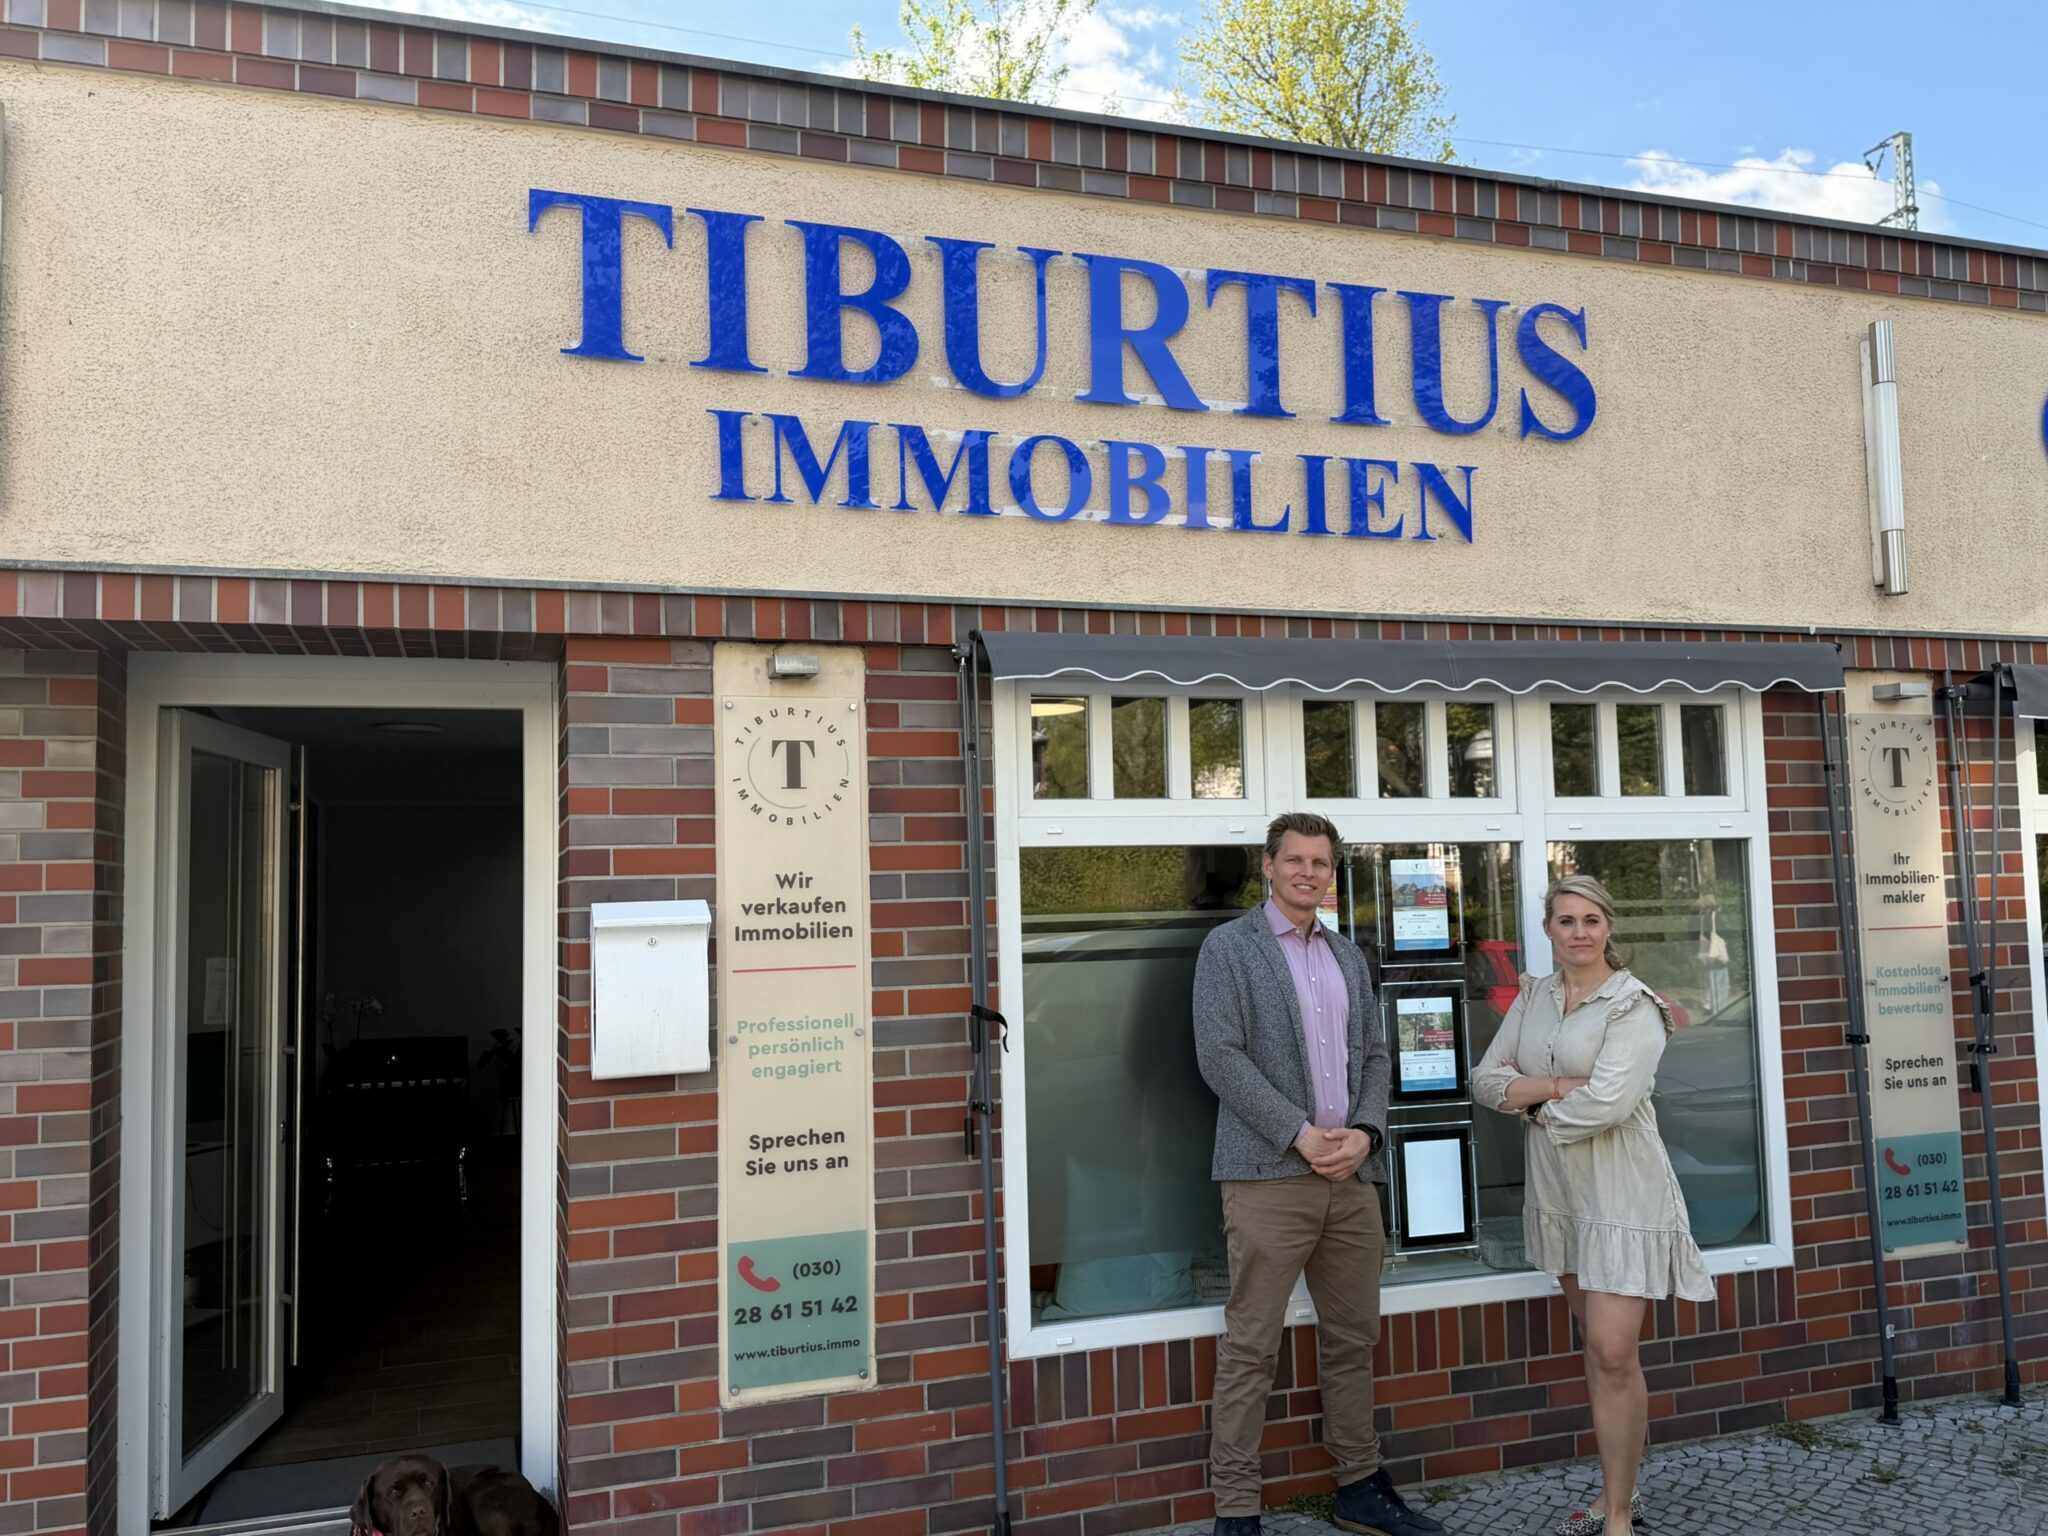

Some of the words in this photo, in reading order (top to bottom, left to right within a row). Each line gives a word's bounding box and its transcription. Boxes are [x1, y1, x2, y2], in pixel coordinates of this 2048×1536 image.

[528, 188, 1597, 441] TIBURTIUS
[706, 408, 1478, 544] IMMOBILIEN
[735, 707, 846, 746] TIBURTIUS
[1860, 720, 1929, 753] TIBURTIUS
[771, 740, 816, 789] T
[1882, 747, 1910, 788] T
[732, 777, 850, 826] IMMOBILIEN
[1860, 777, 1932, 817] IMMOBILIEN
[1893, 851, 1911, 866] Ihr
[775, 872, 813, 889] Wir
[1865, 872, 1940, 885] Immobilien-
[741, 897, 846, 916] verkaufen
[1883, 891, 1926, 904] makler
[735, 921, 853, 942] Immobilien
[1875, 964, 1942, 979] Kostenlose
[1874, 983, 1946, 997] Immobilien-
[1878, 1001, 1944, 1016] bewertung
[737, 1013, 855, 1035] Professionell
[748, 1036, 844, 1058] persönlich
[751, 1060, 842, 1080] engagiert
[1885, 1055, 1944, 1072] Sprechen
[1884, 1077, 1904, 1090] Sie
[1909, 1077, 1929, 1089] uns
[1932, 1076, 1947, 1087] an
[749, 1128, 845, 1153] Sprechen
[745, 1158, 776, 1176] Sie
[783, 1159, 818, 1172] uns
[825, 1156, 849, 1170] an
[1917, 1152, 1948, 1168] (030)
[1884, 1186, 1902, 1200] 28
[1906, 1184, 1920, 1197] 61
[1924, 1182, 1938, 1195] 51
[1942, 1180, 1959, 1193] 42
[1887, 1211, 1962, 1227] www.tiburtius.immo
[793, 1258, 841, 1280] (030)
[734, 1306, 762, 1326] 28
[770, 1303, 792, 1321] 61
[800, 1300, 823, 1317] 51
[831, 1295, 858, 1314] 42
[734, 1338, 861, 1361] www.tiburtius.immo
